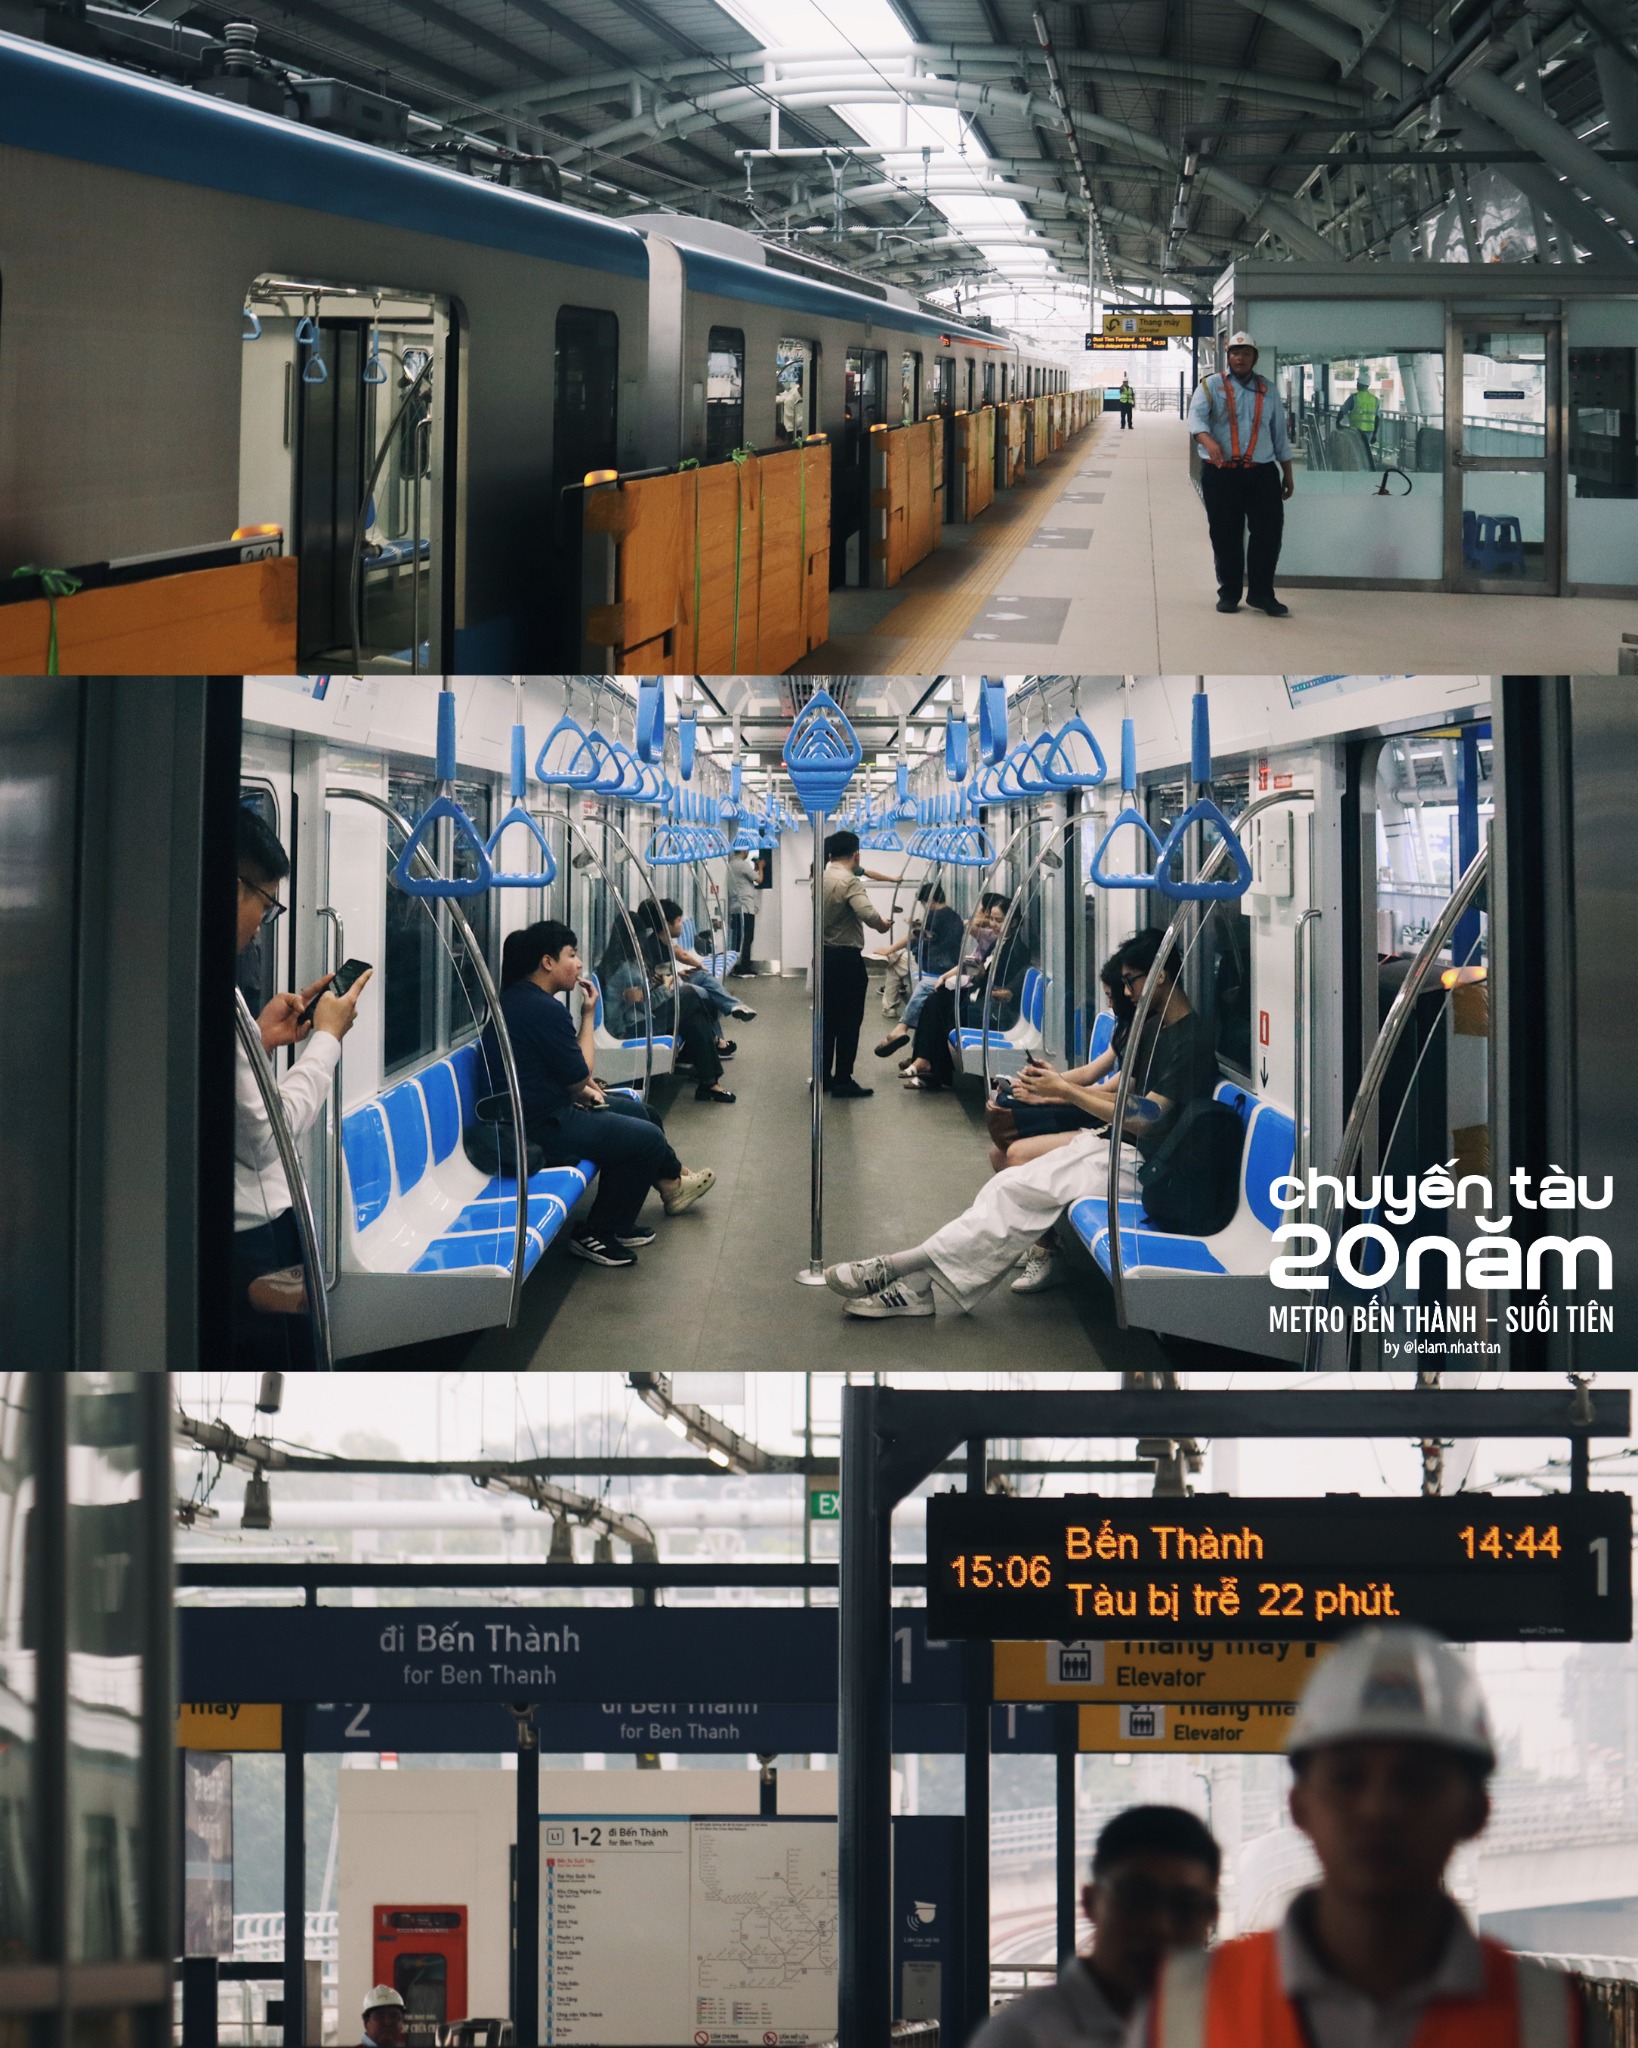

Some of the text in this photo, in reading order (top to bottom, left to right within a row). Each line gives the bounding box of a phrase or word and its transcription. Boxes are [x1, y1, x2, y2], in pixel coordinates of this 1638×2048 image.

[1065, 1519, 1562, 1560] Bến Thành 14:44
[950, 1555, 1051, 1588] 15:06
[1589, 1537, 1608, 1597] 1
[1065, 1576, 1400, 1622] Tàu bị trễ 22 phút.
[379, 1621, 580, 1653] đi Bến Thành
[894, 1627, 912, 1684] 1
[403, 1665, 557, 1685] for Ben Thanh
[1117, 1666, 1206, 1687] Elevator
[344, 1703, 371, 1738] 2
[620, 1723, 740, 1740] for Ben Thanh
[1174, 1725, 1244, 1740] Elevator
[551, 1833, 560, 1841] L1
[572, 1827, 602, 1846] 1-2
[608, 1827, 668, 1837] đi Bến Thành
